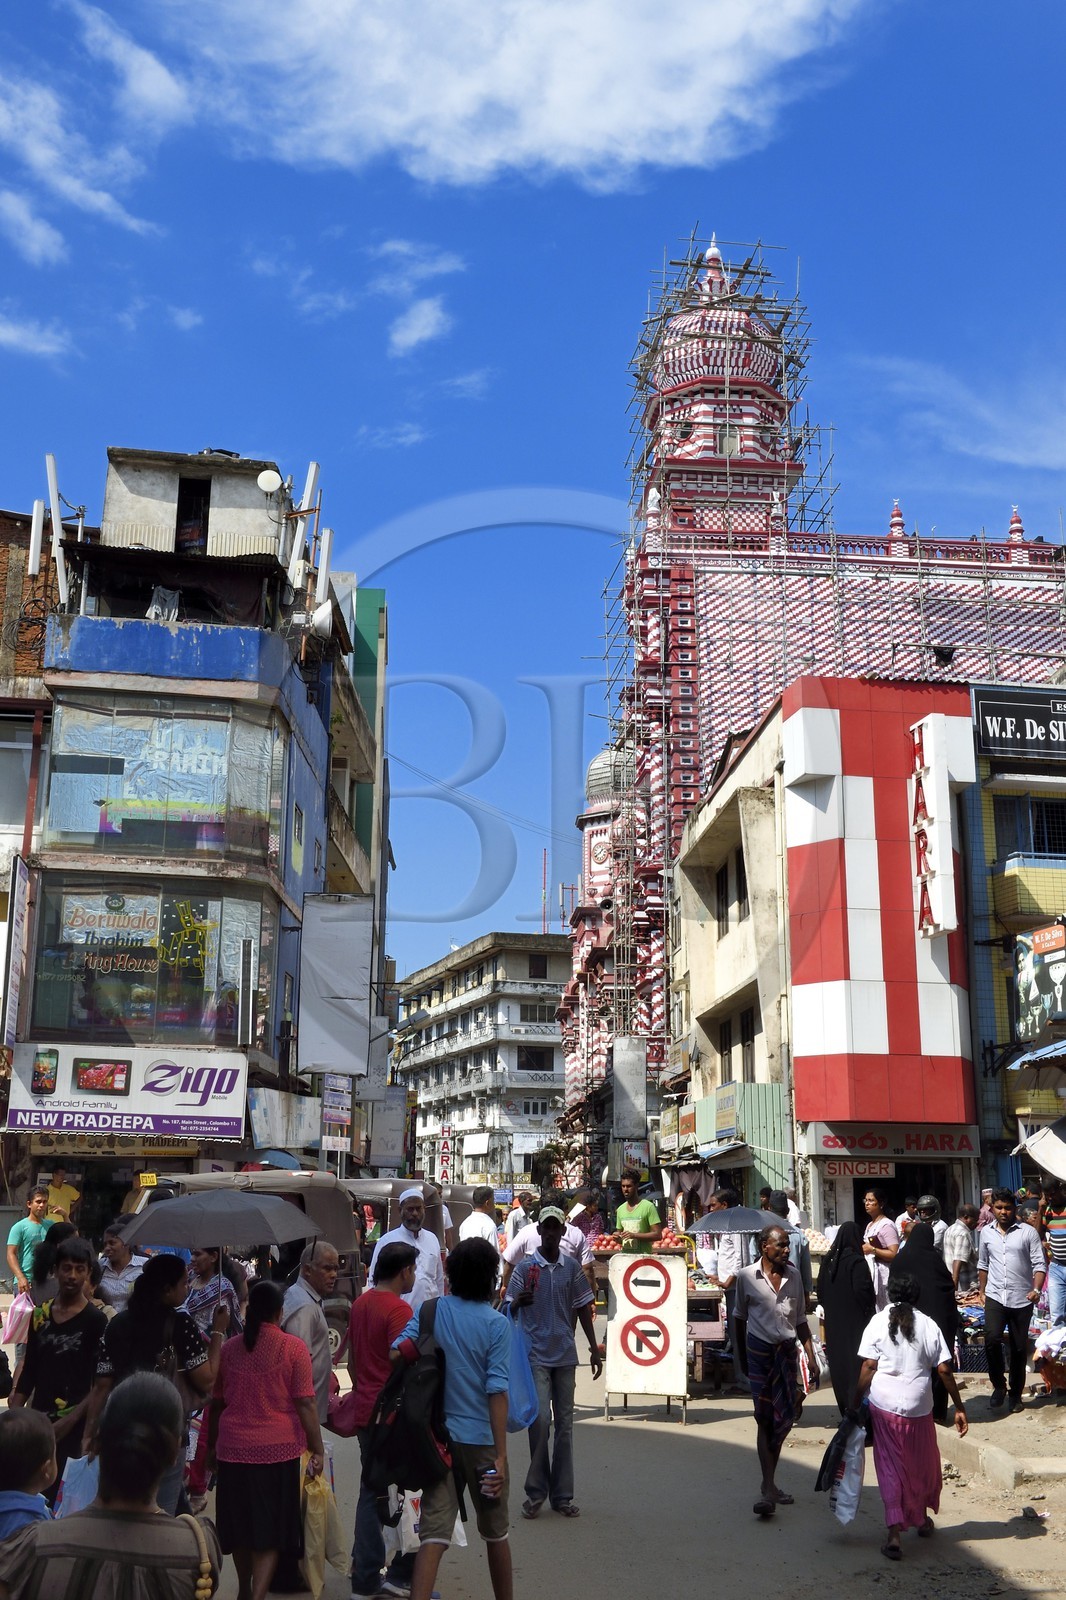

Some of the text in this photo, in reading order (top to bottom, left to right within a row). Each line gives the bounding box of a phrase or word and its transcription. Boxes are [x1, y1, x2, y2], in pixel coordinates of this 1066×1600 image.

[985, 716, 1020, 739] W.F.
[1024, 718, 1046, 740] De
[910, 724, 936, 931] HARA
[67, 905, 158, 930] Beruwala
[84, 931, 144, 947] Ibrahim
[113, 953, 159, 973] House
[36, 1099, 118, 1110] Android Family
[16, 1112, 154, 1130] NEW PRADEEPA
[142, 1137, 188, 1147] PRADEEPA
[905, 1133, 974, 1151] HARA
[441, 1126, 451, 1181] HARA
[827, 1161, 890, 1175] SINGER
